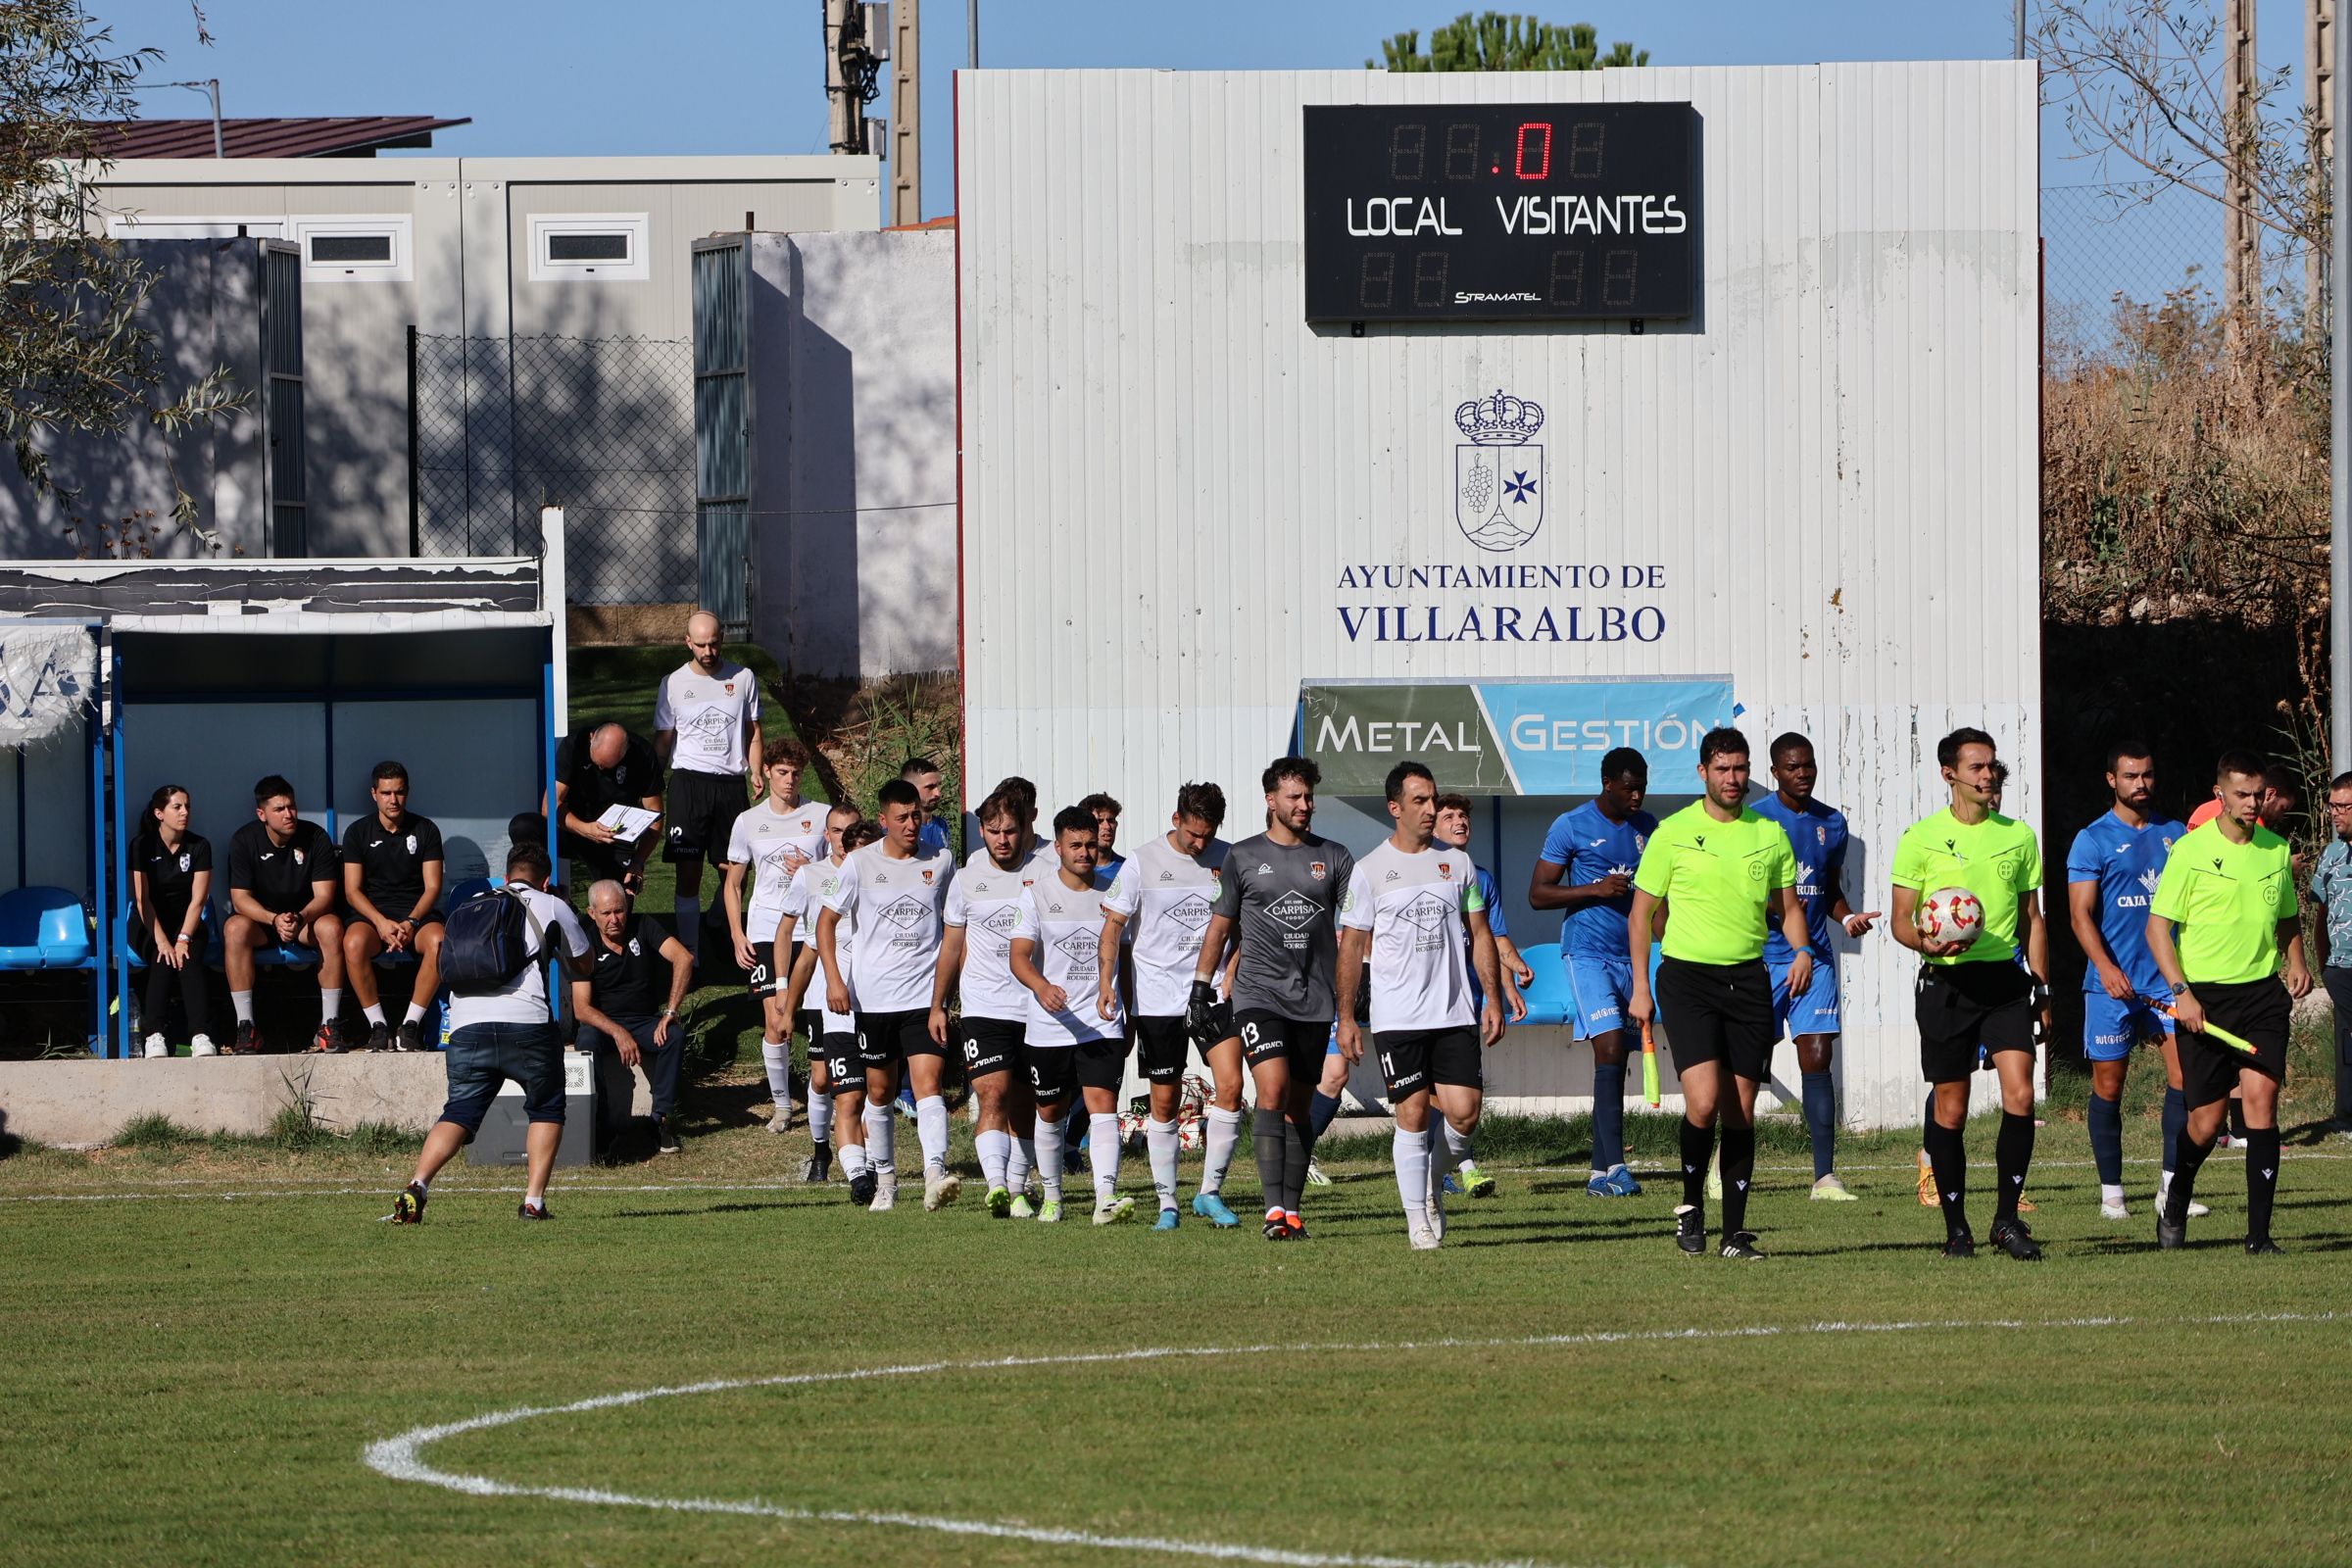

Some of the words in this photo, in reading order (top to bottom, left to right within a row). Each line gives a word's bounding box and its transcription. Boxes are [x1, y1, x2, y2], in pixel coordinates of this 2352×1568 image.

[1348, 197, 1462, 236] LOCAL
[1496, 195, 1687, 234] VISITANTES
[1454, 292, 1542, 304] STRAMATEL
[1337, 564, 1610, 589] AYUNTAMIENTO
[1621, 564, 1666, 589] DE
[1337, 606, 1666, 642] VILLARALBO
[670, 826, 683, 844] 12
[1272, 905, 1315, 915] CARPISA
[2118, 895, 2147, 907] CAJA
[1406, 906, 1447, 918] CARPISA
[1415, 943, 1446, 954] RODRIGO
[1417, 934, 1444, 943] CIUDAD
[751, 964, 766, 984] 20
[1241, 1022, 1260, 1048] 13
[963, 1039, 979, 1061] 18
[829, 1057, 847, 1078] 16
[1381, 1052, 1395, 1078] 11
